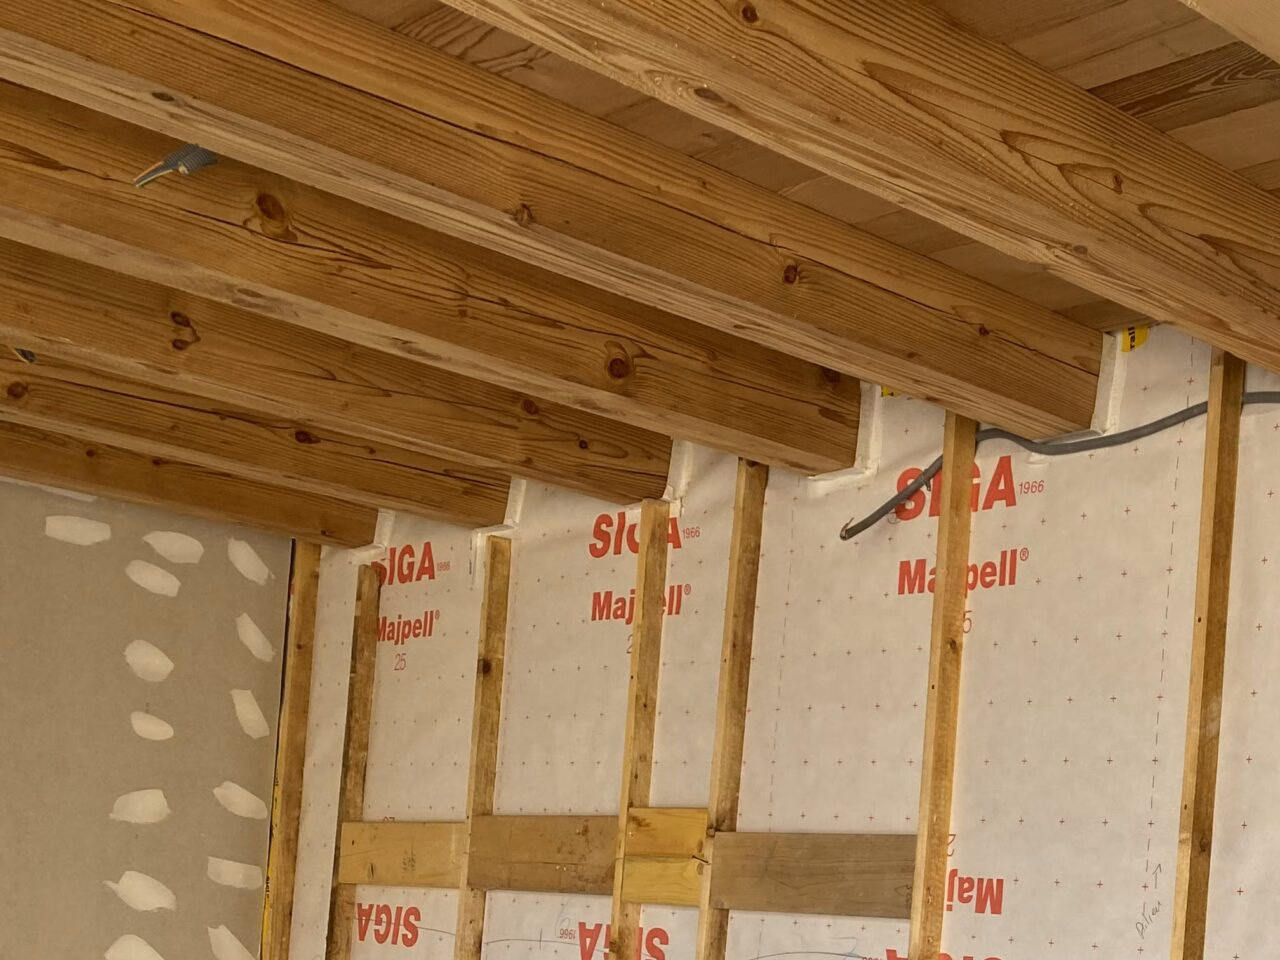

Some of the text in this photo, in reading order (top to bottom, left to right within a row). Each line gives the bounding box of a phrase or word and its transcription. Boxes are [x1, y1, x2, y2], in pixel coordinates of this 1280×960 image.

[1019, 480, 1045, 496] 1966
[683, 526, 700, 540] 1966
[394, 653, 407, 671] 25
[356, 903, 421, 948] SIGA
